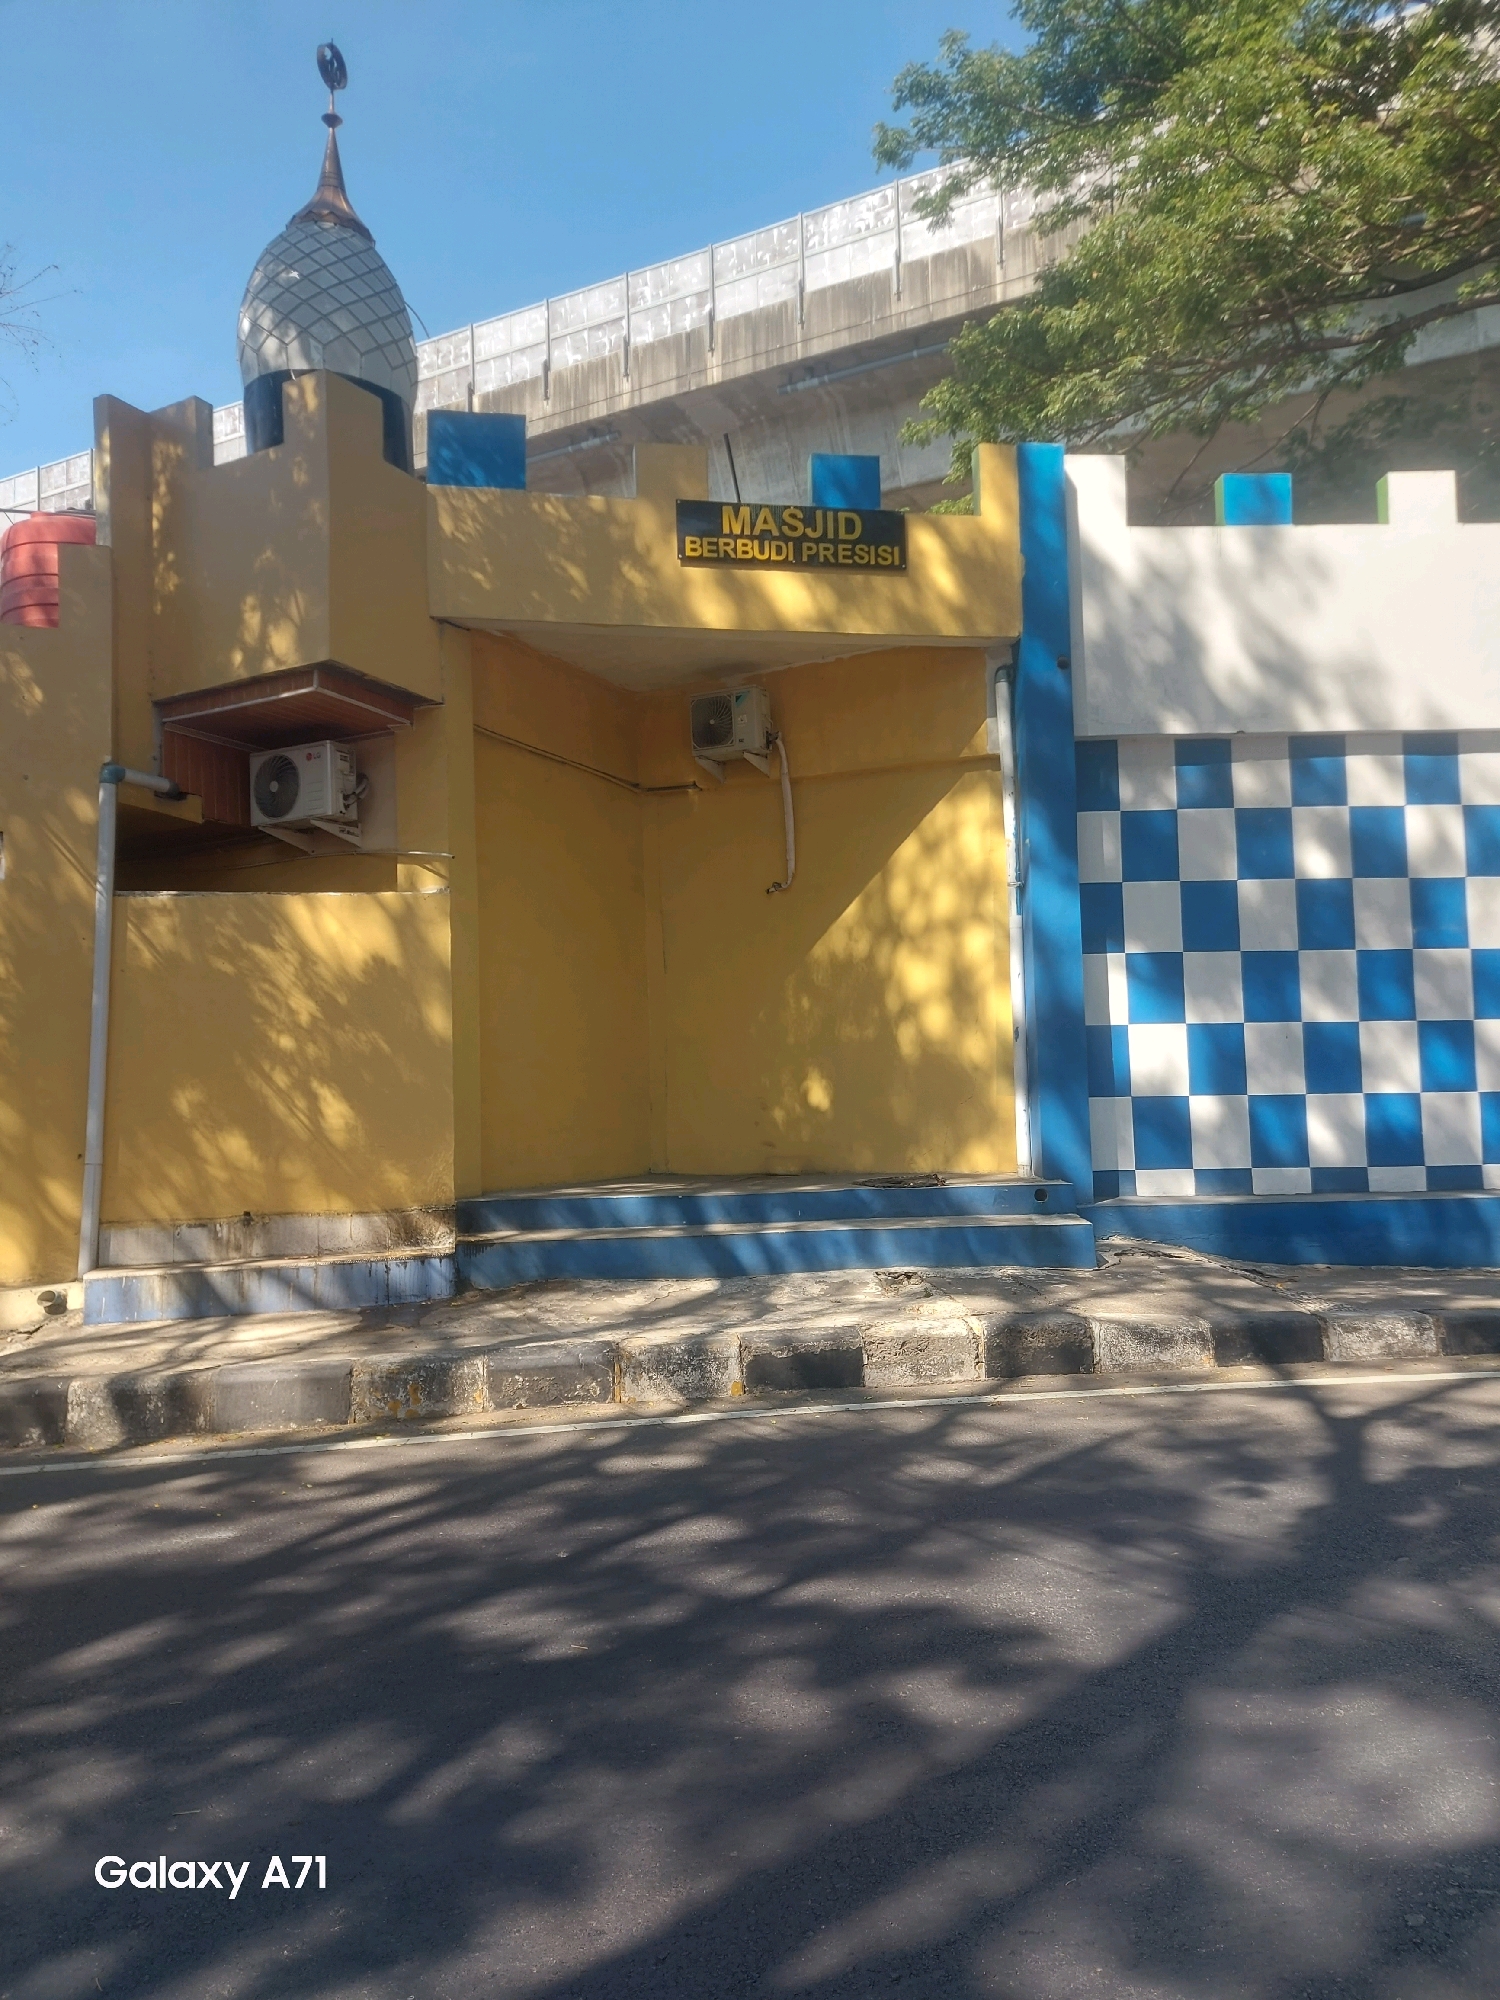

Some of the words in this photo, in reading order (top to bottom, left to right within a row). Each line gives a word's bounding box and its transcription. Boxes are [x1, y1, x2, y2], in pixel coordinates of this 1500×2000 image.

[722, 505, 863, 540] MASJID
[685, 536, 794, 562] BERBUDI
[802, 542, 900, 566] PRESISI
